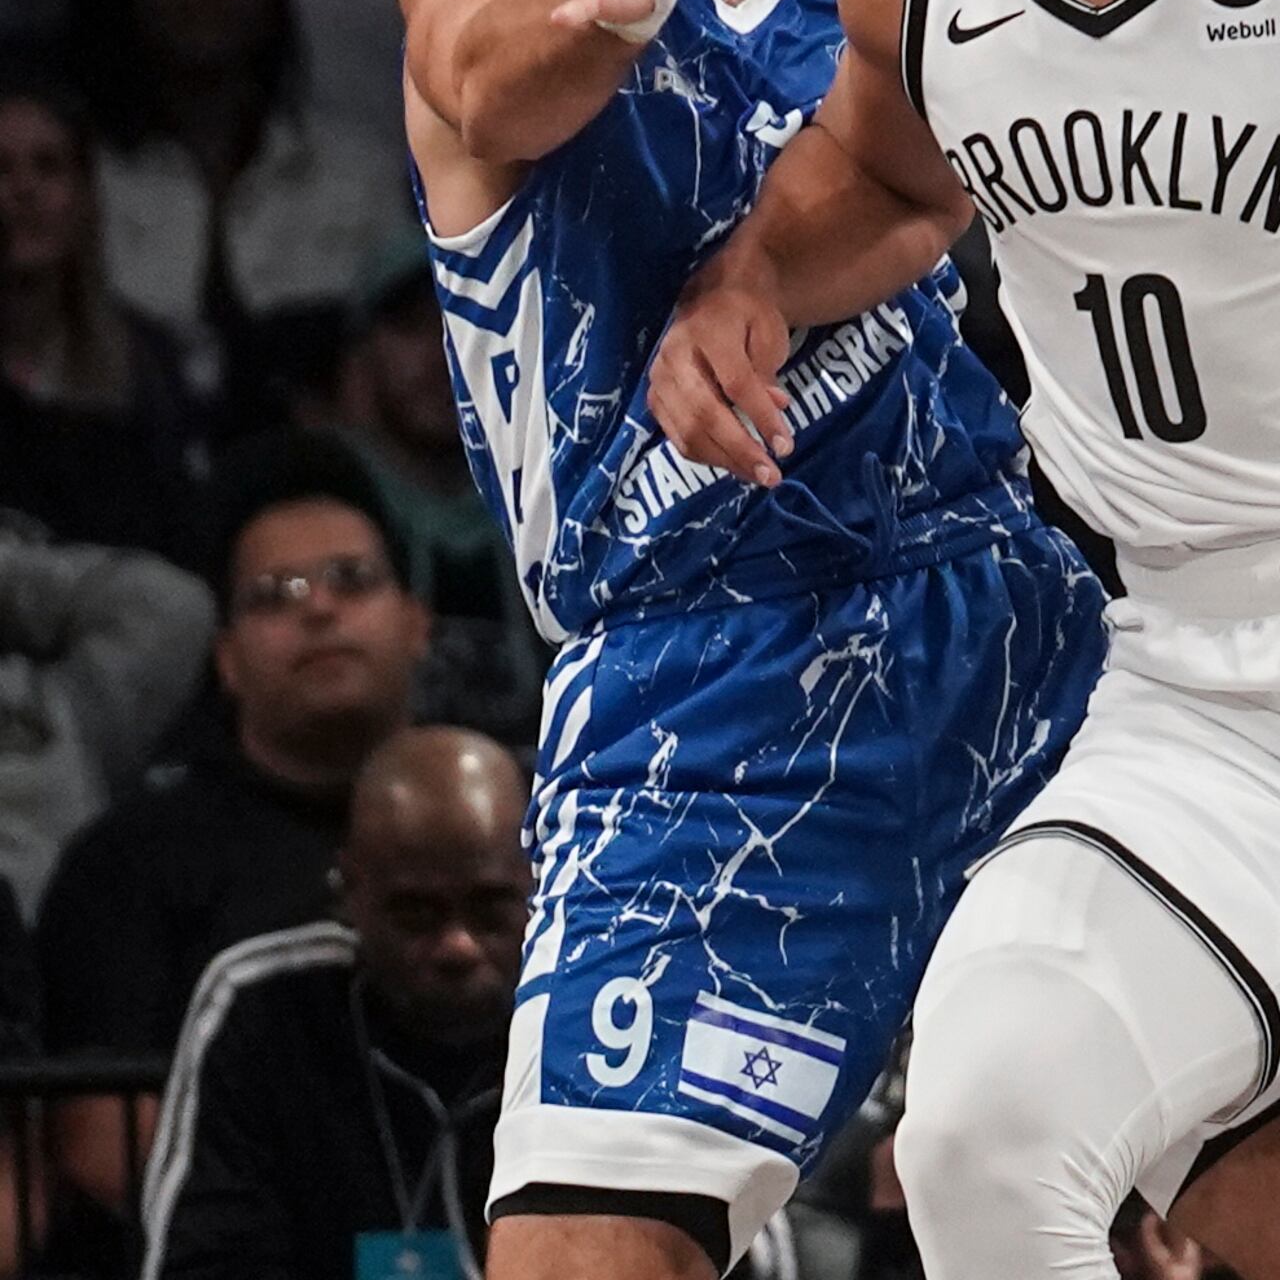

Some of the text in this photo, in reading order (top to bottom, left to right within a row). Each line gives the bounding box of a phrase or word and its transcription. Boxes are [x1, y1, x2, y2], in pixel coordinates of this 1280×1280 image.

[1206, 18, 1276, 43] Webull
[1073, 272, 1208, 444] 10
[585, 976, 653, 1088] 9
